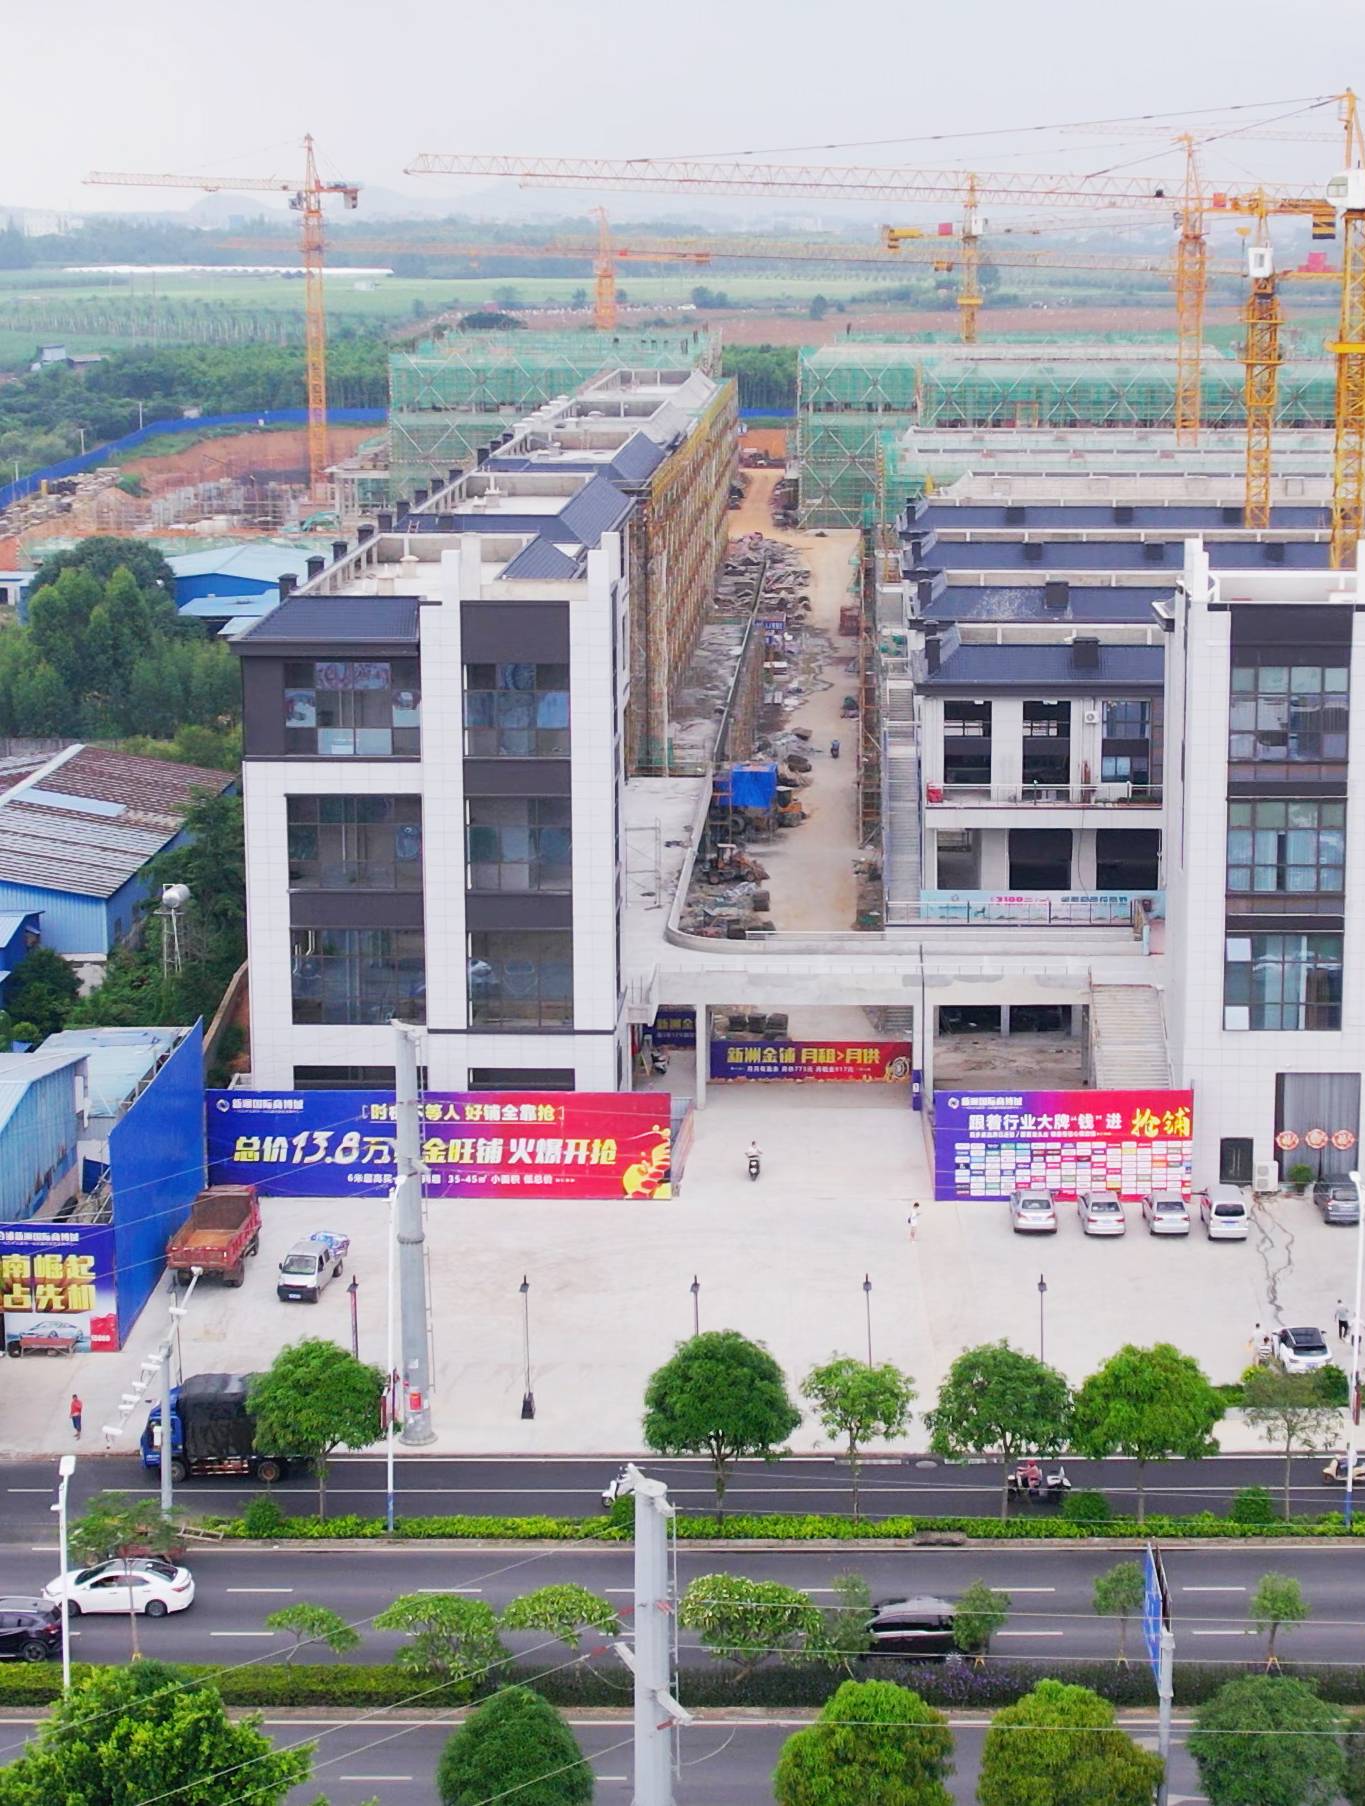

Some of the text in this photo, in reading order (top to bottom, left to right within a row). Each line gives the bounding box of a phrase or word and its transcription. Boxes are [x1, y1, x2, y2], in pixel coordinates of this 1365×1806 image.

[727, 1047, 796, 1064] 新洲金铺
[371, 1104, 555, 1121] 时等人 好铺全靠抢
[1131, 1106, 1191, 1138] 抢铺
[233, 1130, 618, 1165] 总价13.8万金旺铺 火爆开抢
